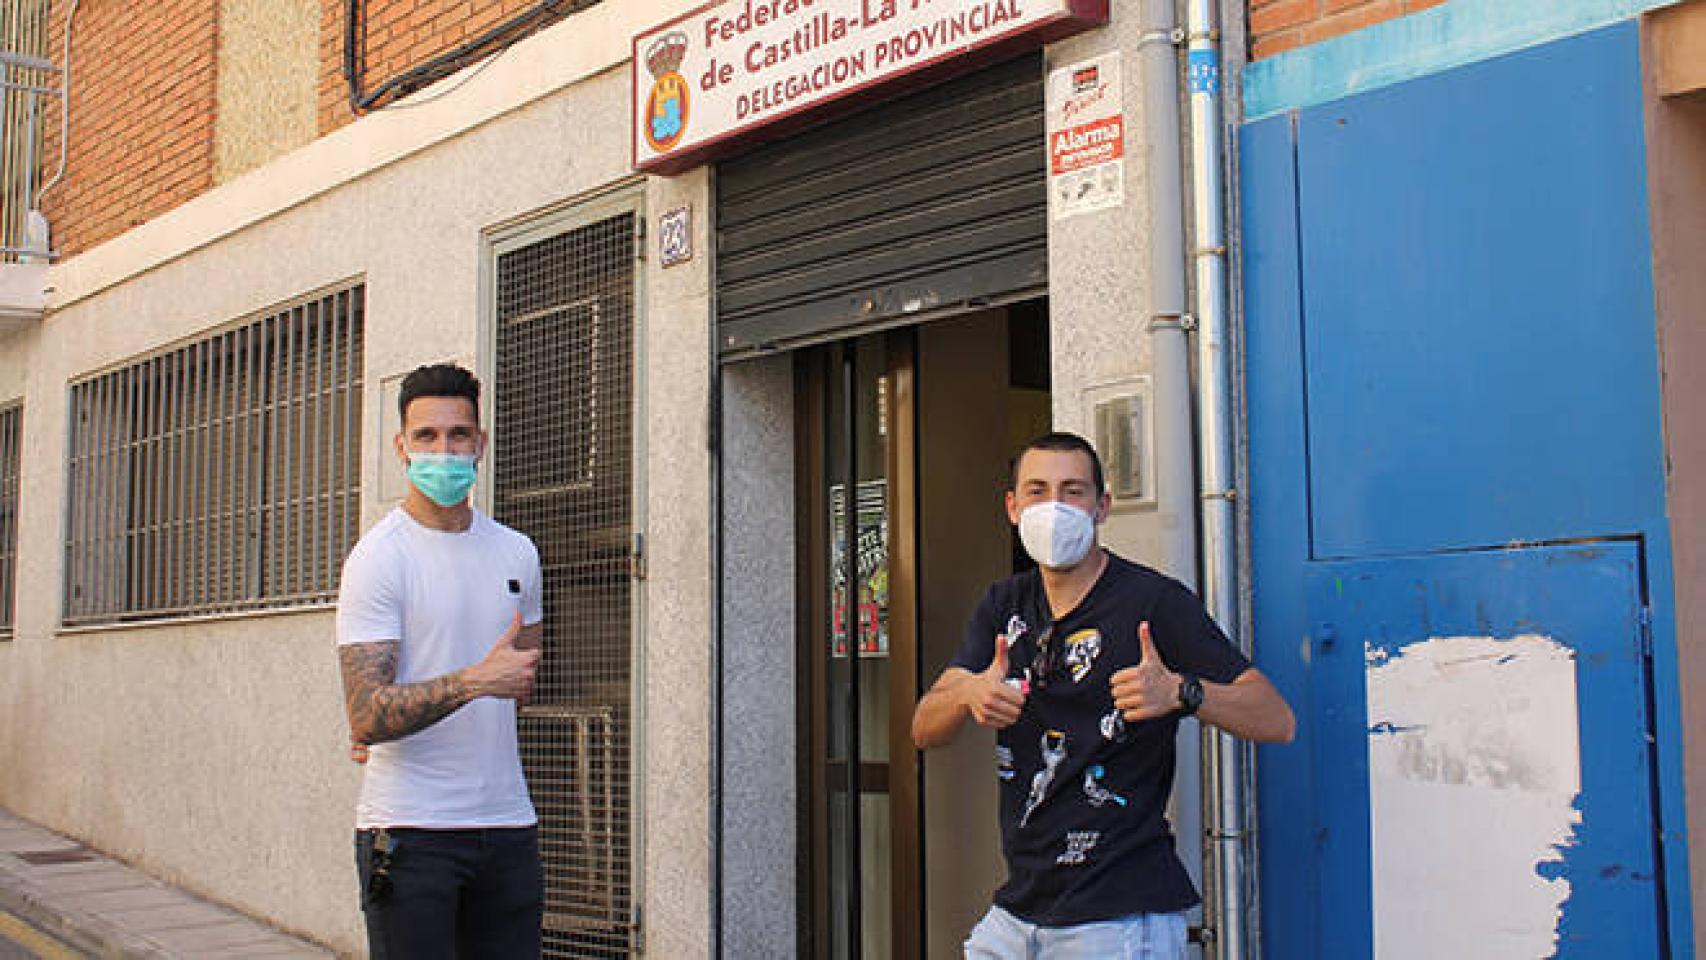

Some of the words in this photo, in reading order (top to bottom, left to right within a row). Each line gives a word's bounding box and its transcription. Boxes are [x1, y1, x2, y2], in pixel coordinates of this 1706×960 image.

[700, 57, 734, 90] de
[745, 0, 899, 73] Castilla-La
[705, 0, 812, 48] Federa
[736, 49, 867, 120] DELEGACION
[875, 0, 1022, 69] PROVINCIAL
[1055, 123, 1120, 156] Alarma
